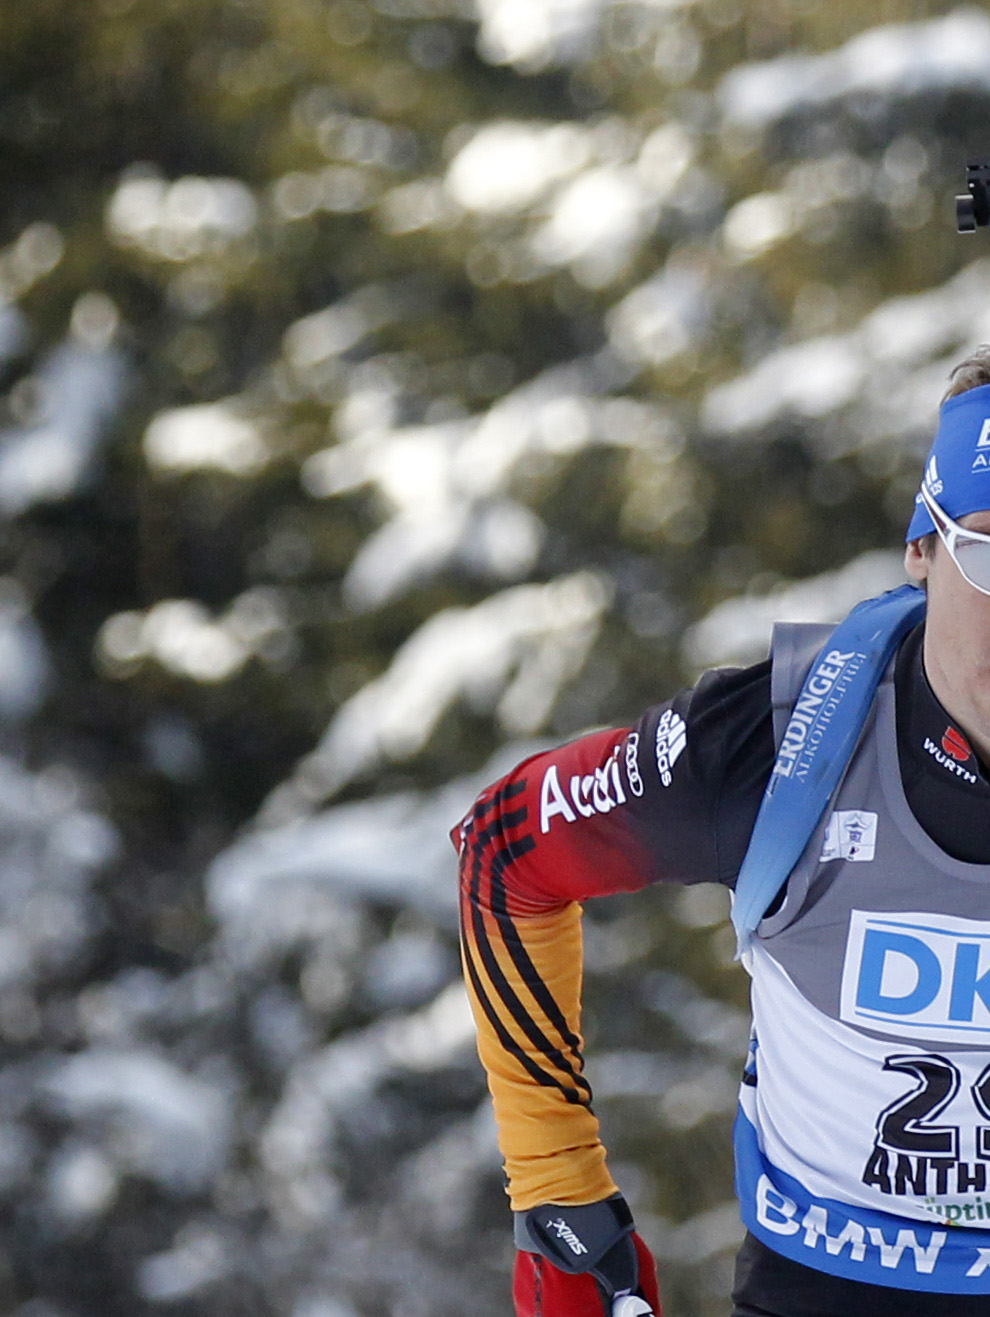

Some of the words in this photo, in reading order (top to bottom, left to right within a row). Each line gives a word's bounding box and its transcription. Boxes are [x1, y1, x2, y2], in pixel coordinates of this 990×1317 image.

[655, 709, 673, 787] adidas
[774, 648, 856, 778] ERDINGER
[795, 652, 868, 782] ALKOHOLFREI
[540, 745, 627, 834] Audi
[756, 1173, 947, 1275] BMW
